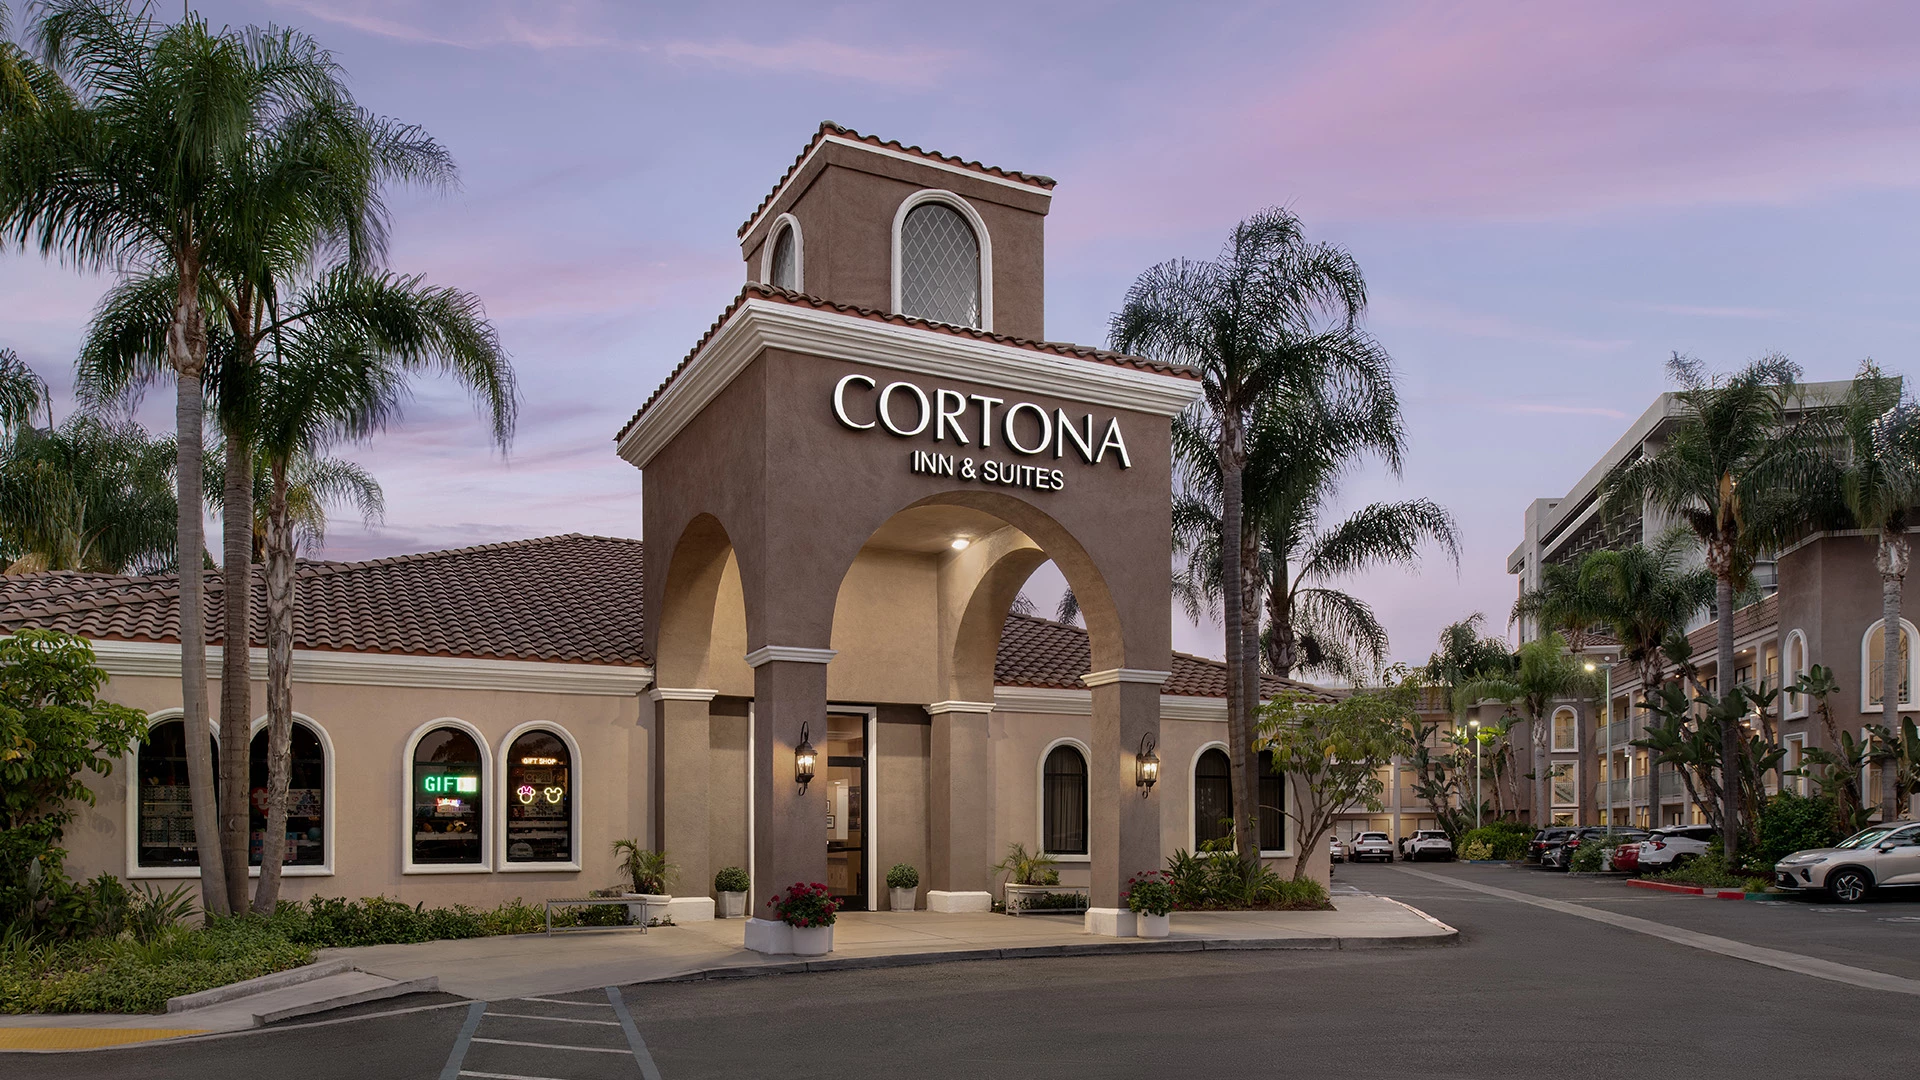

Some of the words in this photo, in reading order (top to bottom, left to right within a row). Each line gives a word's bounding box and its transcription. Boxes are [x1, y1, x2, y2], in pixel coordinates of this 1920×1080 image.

[833, 374, 1132, 469] CORTONA
[914, 450, 954, 476] INN
[961, 457, 977, 480] &
[983, 460, 1064, 491] SUITES
[522, 757, 538, 765] GIFT
[539, 757, 557, 765] SHOP
